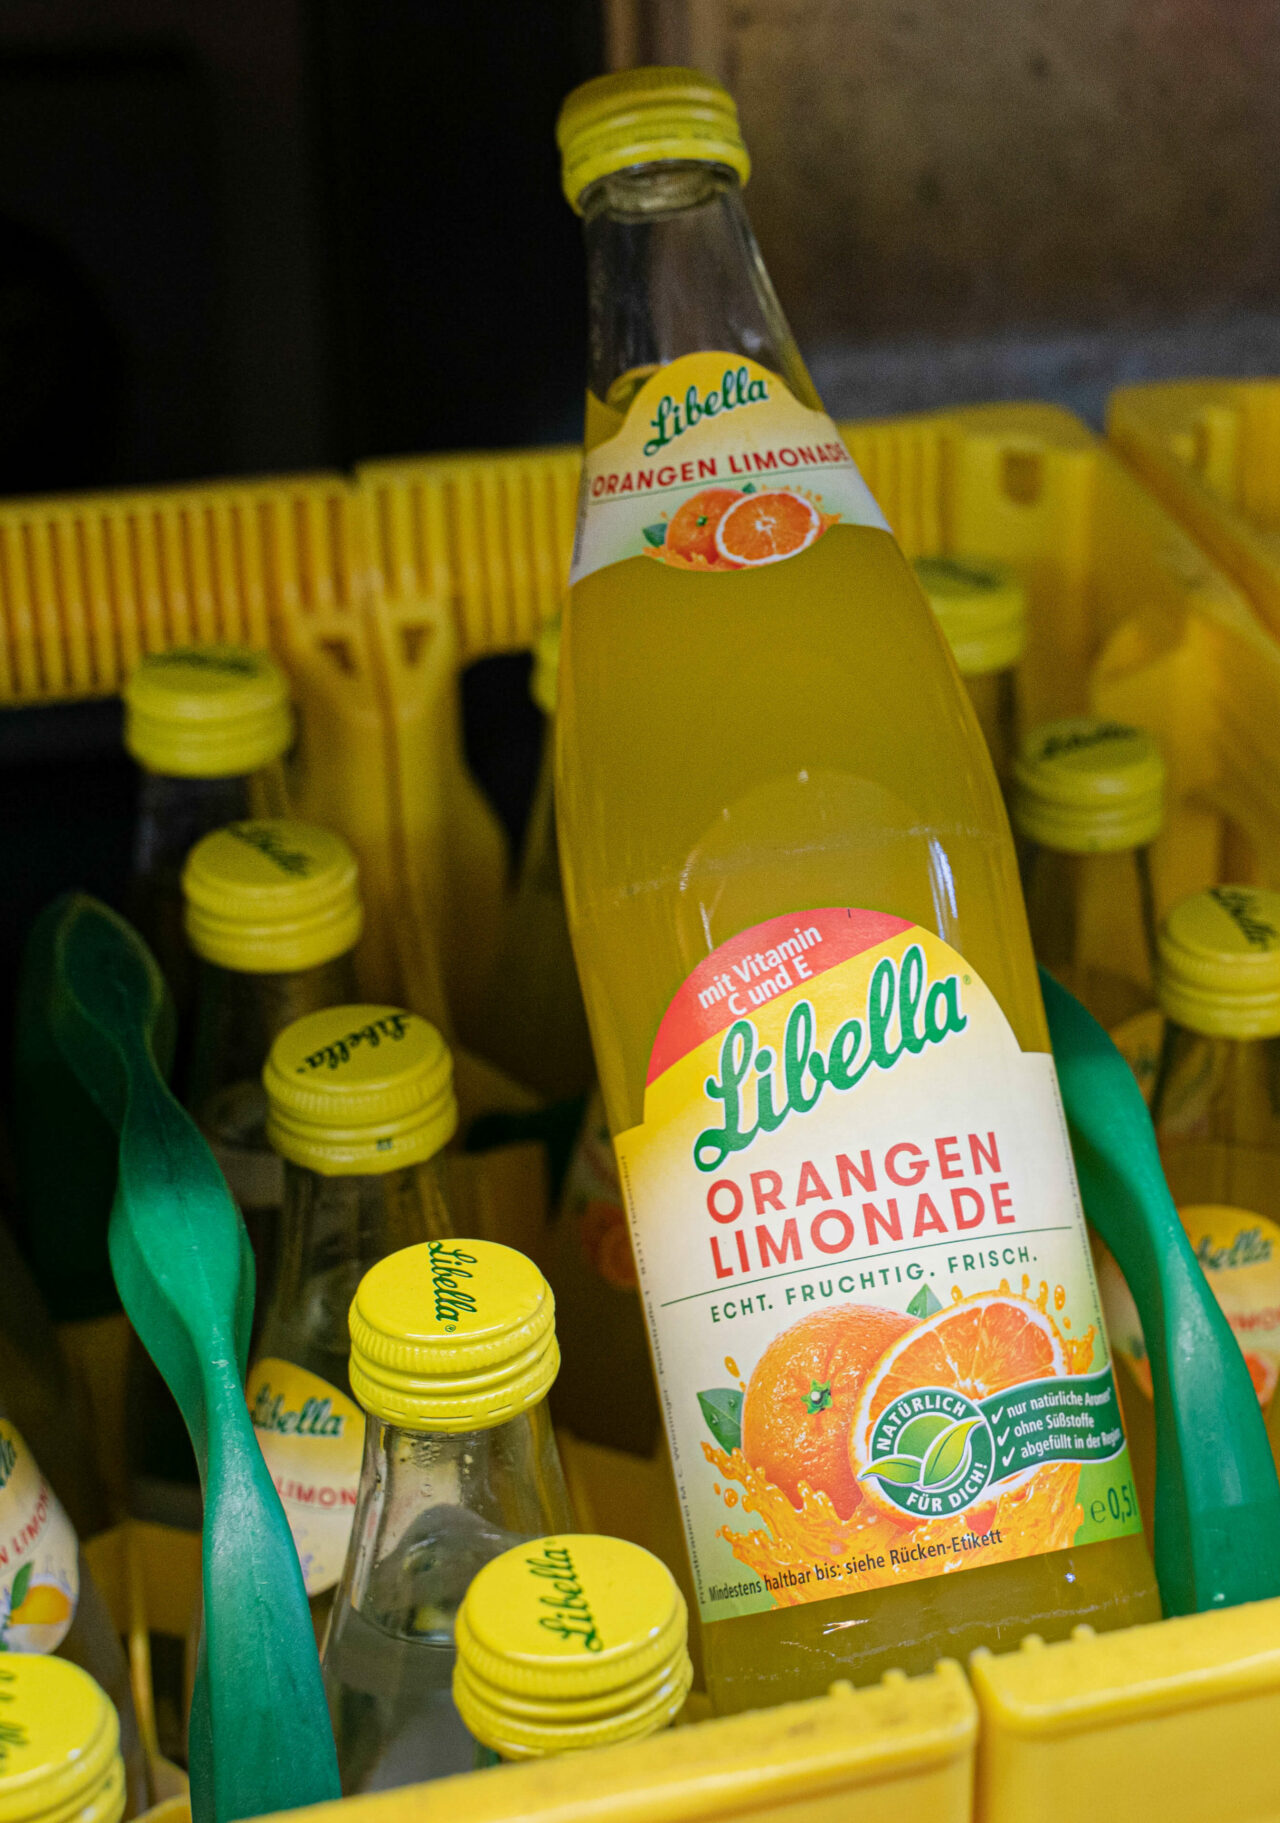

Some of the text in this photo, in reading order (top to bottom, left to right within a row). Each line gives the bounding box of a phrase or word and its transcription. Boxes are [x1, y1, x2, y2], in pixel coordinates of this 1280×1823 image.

[643, 366, 769, 456] Libella
[591, 457, 717, 498] ORANGEN
[698, 926, 823, 1009] mit Vitamin
[728, 954, 813, 1015] C und E
[694, 945, 968, 1173] Libella
[706, 1131, 1002, 1225] ORANGEN
[709, 1182, 1017, 1280] LIMONADE
[428, 1240, 478, 1322] Libella
[711, 1246, 1038, 1324] ECHT. FRUCHTIG. FRISCH.
[876, 1395, 967, 1451] NATÜRLICH
[1006, 1401, 1027, 1419] nur
[1029, 1390, 1083, 1410] natürliche
[1014, 1412, 1095, 1438] ohne Süßstoffe
[1021, 1433, 1072, 1459] abgefüllt
[1074, 1433, 1085, 1449] in
[1086, 1433, 1101, 1449] der
[906, 1462, 988, 1513] FÜR DICH!
[526, 1547, 604, 1653] Libella
[708, 1528, 1003, 1602] Mindestens haltbar bis: siehe Rücken-Etikett
